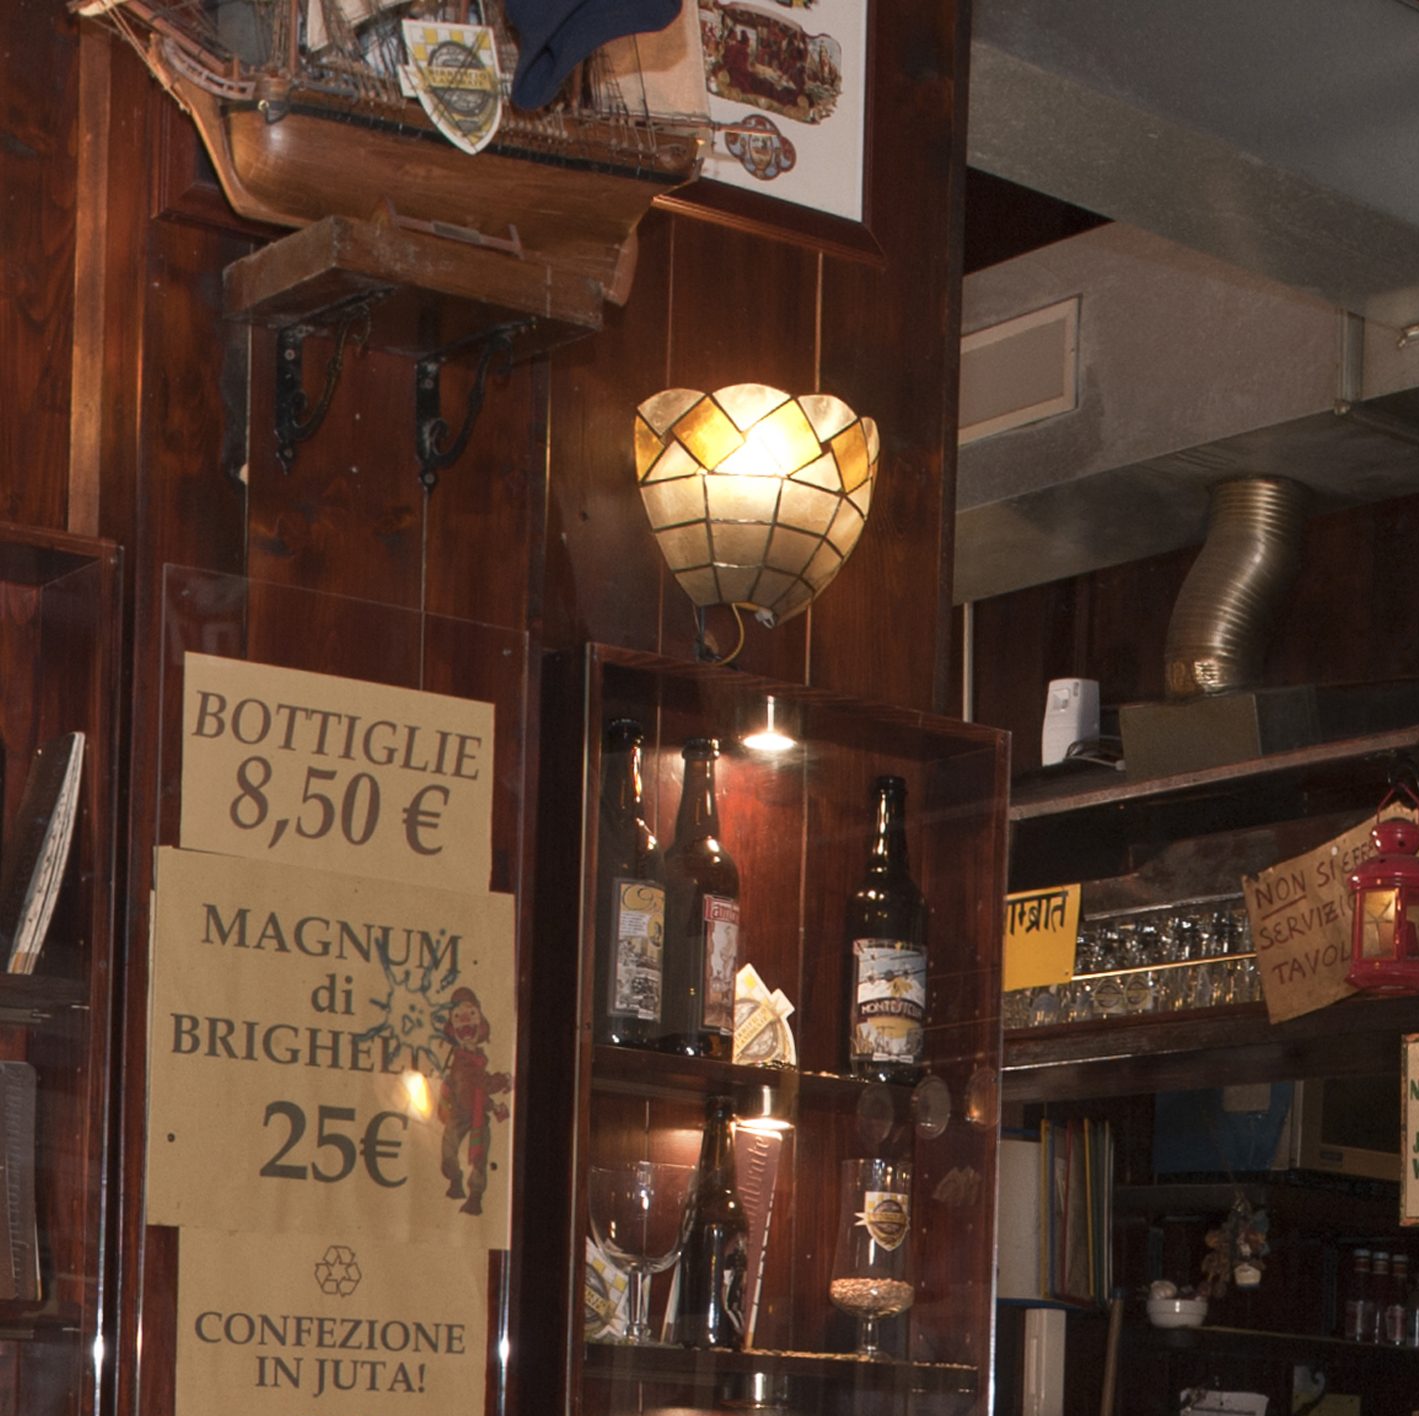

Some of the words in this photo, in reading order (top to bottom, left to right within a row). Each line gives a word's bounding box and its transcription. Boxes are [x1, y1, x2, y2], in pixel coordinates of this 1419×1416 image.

[192, 690, 482, 781] BOTTIGLIE
[229, 755, 381, 848] 8,50
[402, 784, 450, 855] €
[1254, 870, 1307, 909] NON
[1317, 862, 1335, 888] SI
[201, 903, 463, 974] MAGNUM
[1272, 942, 1350, 985] TAVOL
[310, 974, 356, 1017] di
[259, 1101, 409, 1188] 25€
[194, 1311, 466, 1354] CONFEZIONE
[255, 1356, 300, 1388] IN
[312, 1356, 427, 1397] JUTA!
